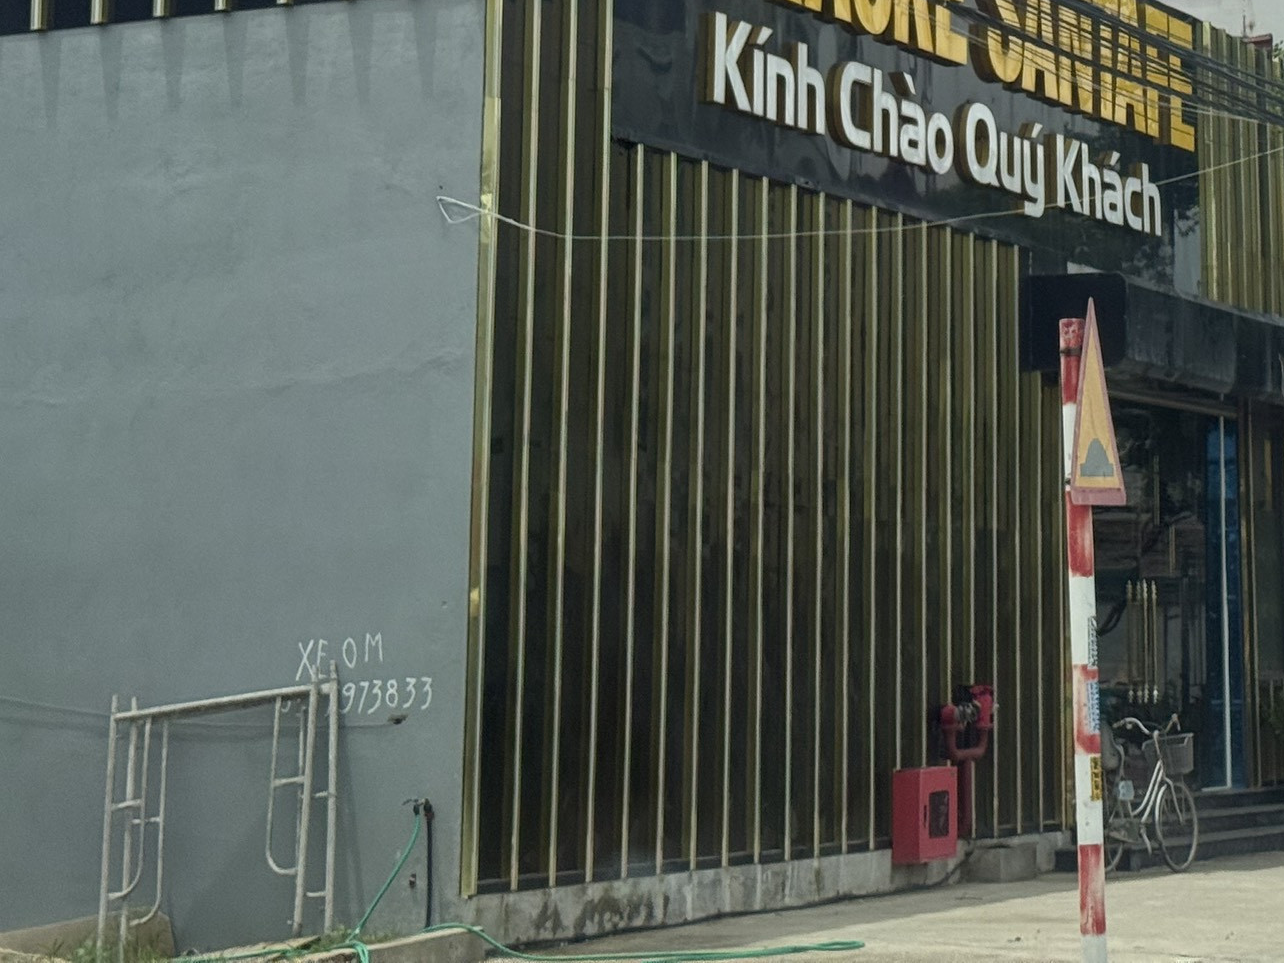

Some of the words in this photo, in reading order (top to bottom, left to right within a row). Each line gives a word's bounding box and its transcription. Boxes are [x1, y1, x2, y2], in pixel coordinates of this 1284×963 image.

[712, 11, 826, 135] Kính
[838, 60, 954, 175] Chào
[962, 101, 1045, 218] Quý
[1055, 133, 1162, 236] Khách
[296, 639, 329, 681] XE
